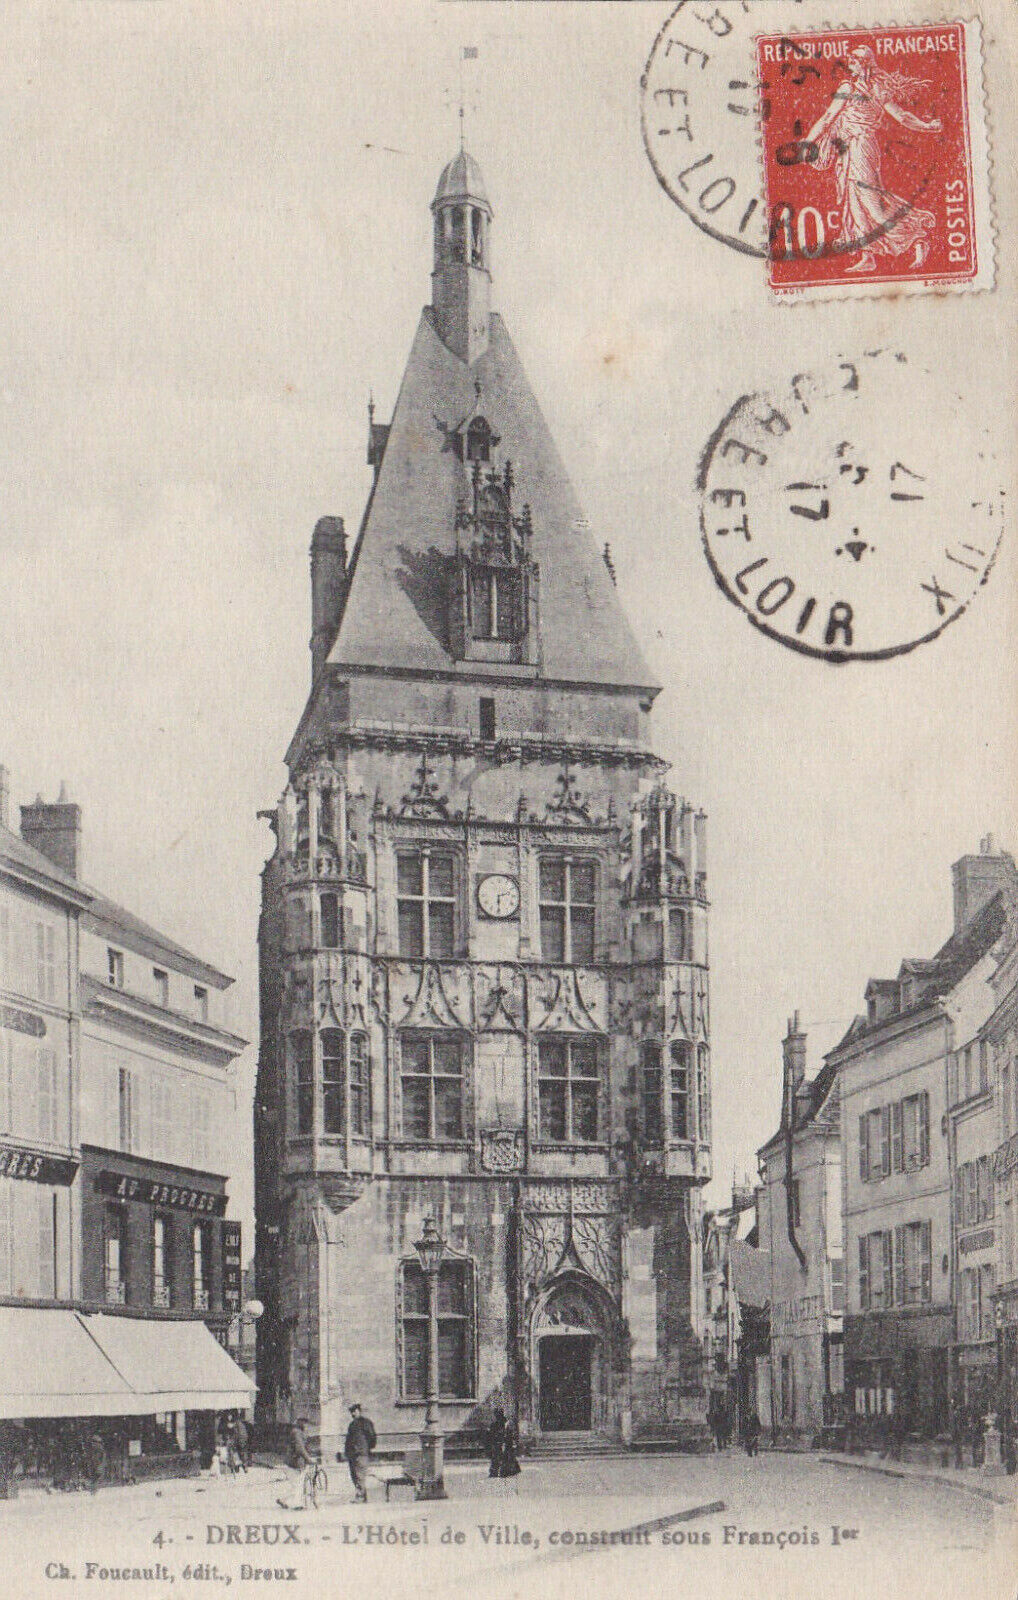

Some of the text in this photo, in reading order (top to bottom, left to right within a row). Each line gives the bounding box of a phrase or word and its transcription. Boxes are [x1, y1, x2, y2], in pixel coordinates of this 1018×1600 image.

[875, 33, 957, 57] FRANÇAISE
[946, 178, 967, 264] POSTES
[734, 557, 853, 646] LOIR
[117, 1177, 140, 1197] AU
